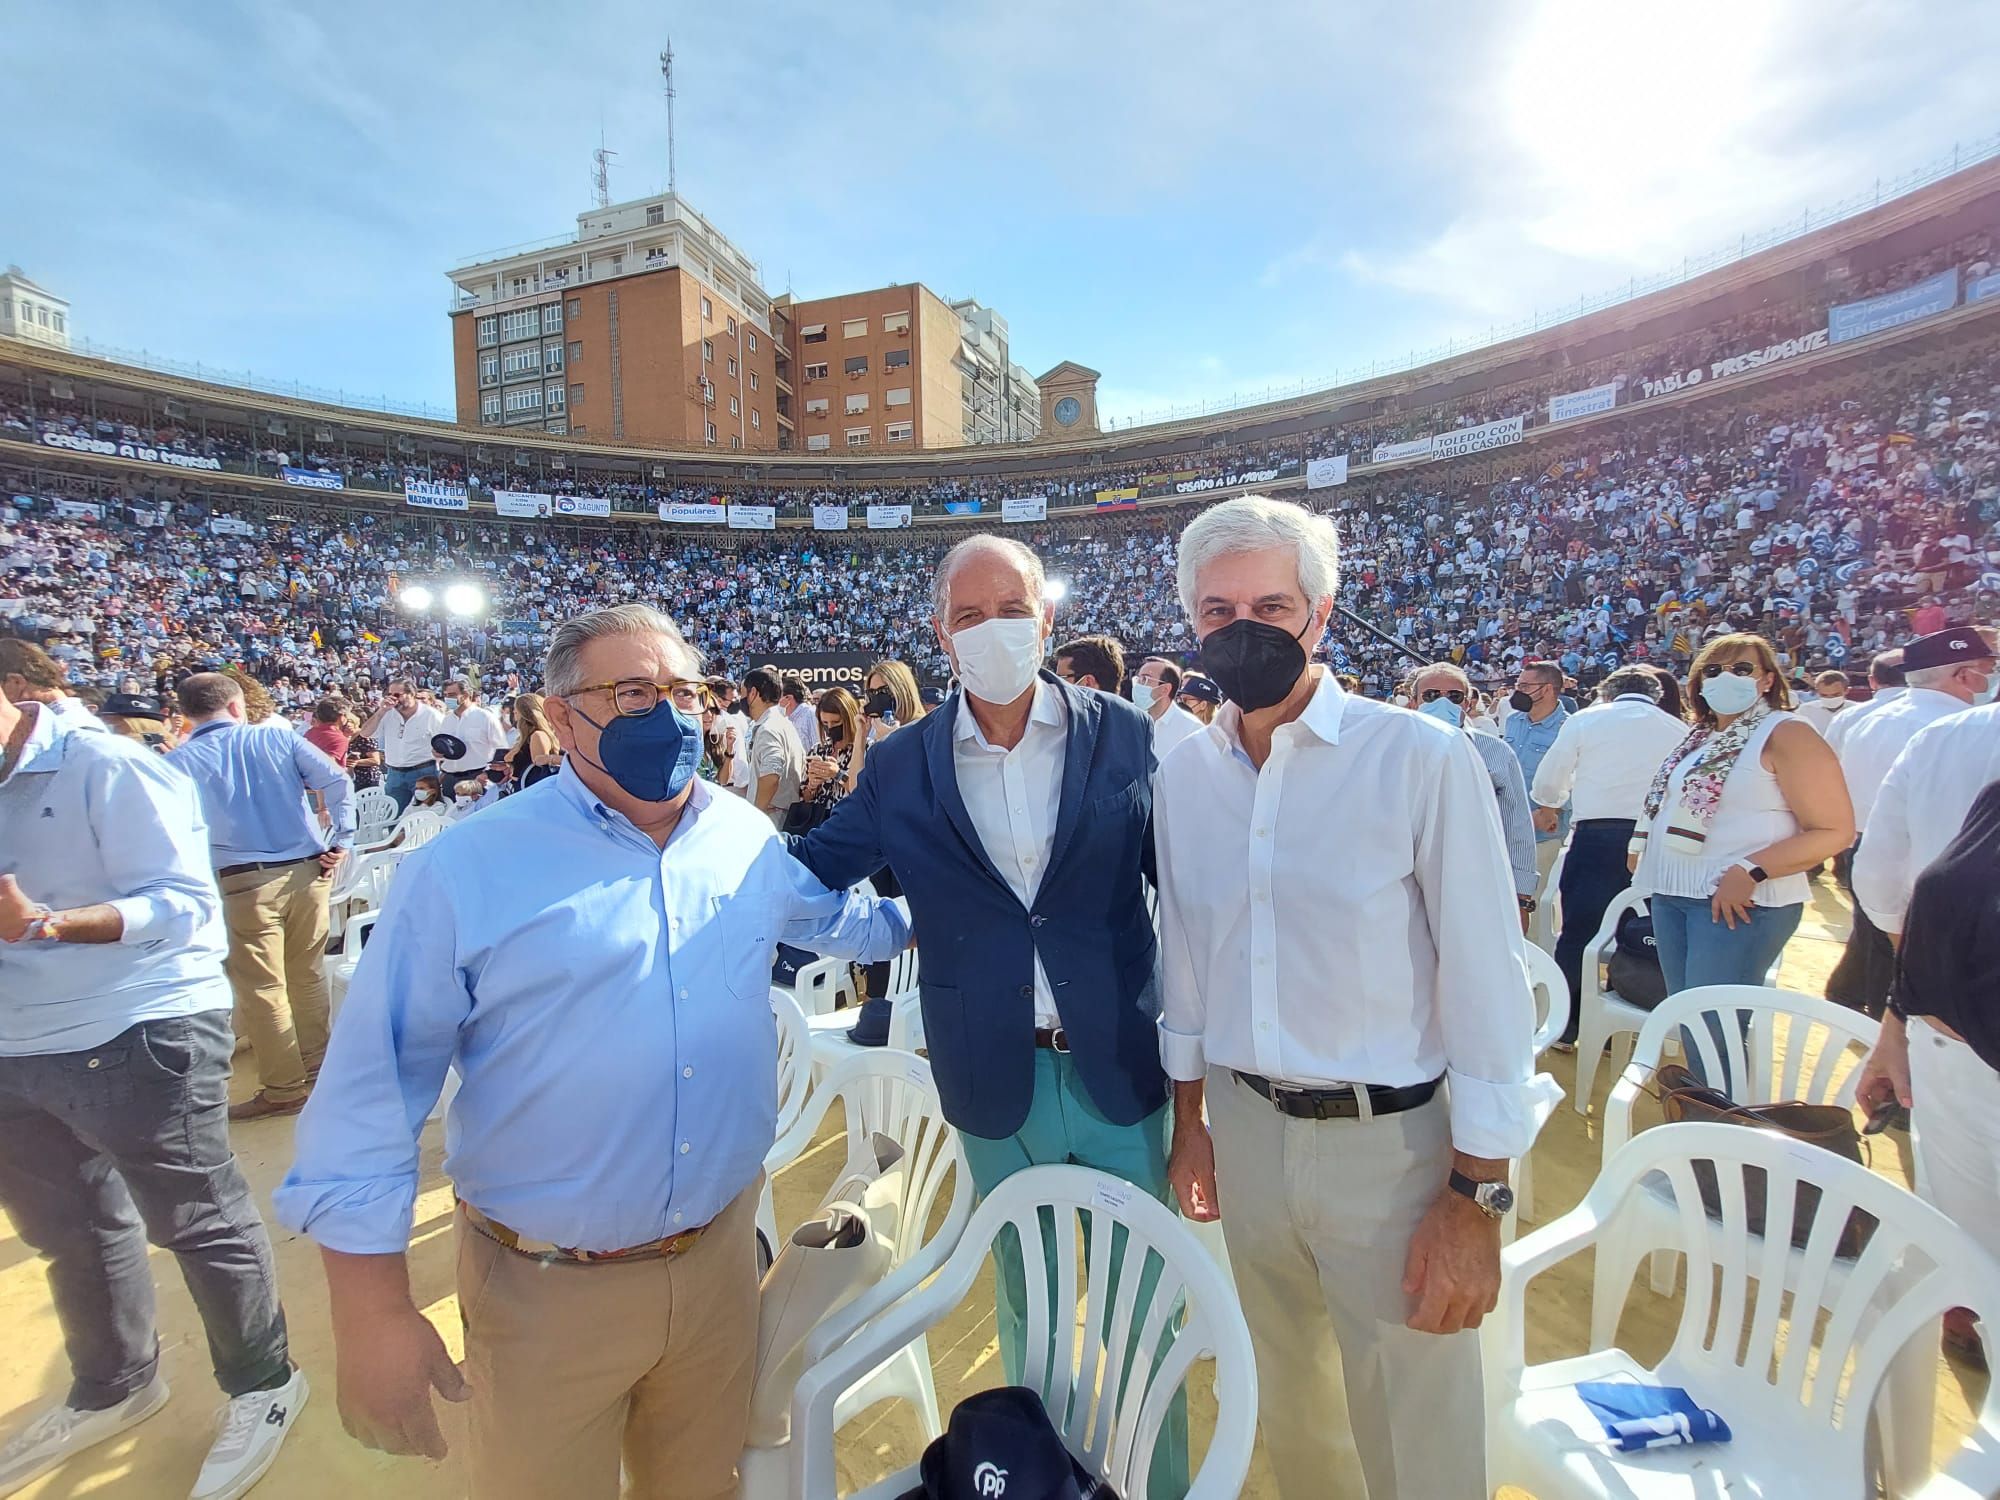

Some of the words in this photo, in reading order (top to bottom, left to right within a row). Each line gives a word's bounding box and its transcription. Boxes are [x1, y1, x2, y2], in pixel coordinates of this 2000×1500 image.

[1838, 301, 1940, 342] FINESTRAT
[1643, 369, 1702, 399] PABLO
[1710, 327, 1829, 380] PRESIDENTE
[1555, 398, 1612, 420] finestrat
[1438, 430, 1486, 448] TOLEDO
[1489, 421, 1518, 437] CON
[43, 432, 117, 455] CASADO
[120, 445, 136, 459] A
[138, 447, 158, 462] LA
[1432, 442, 1469, 461] PABLO
[1471, 431, 1521, 452] CASADO
[287, 476, 344, 490] CASADO
[407, 483, 442, 495] SANTA
[443, 485, 467, 497] POLA
[1176, 478, 1215, 493] CASADO
[1215, 477, 1225, 488] A
[1226, 475, 1238, 486] LA
[433, 497, 464, 508] CASADO
[577, 502, 609, 513] SAGUNTO
[671, 507, 717, 516] populares
